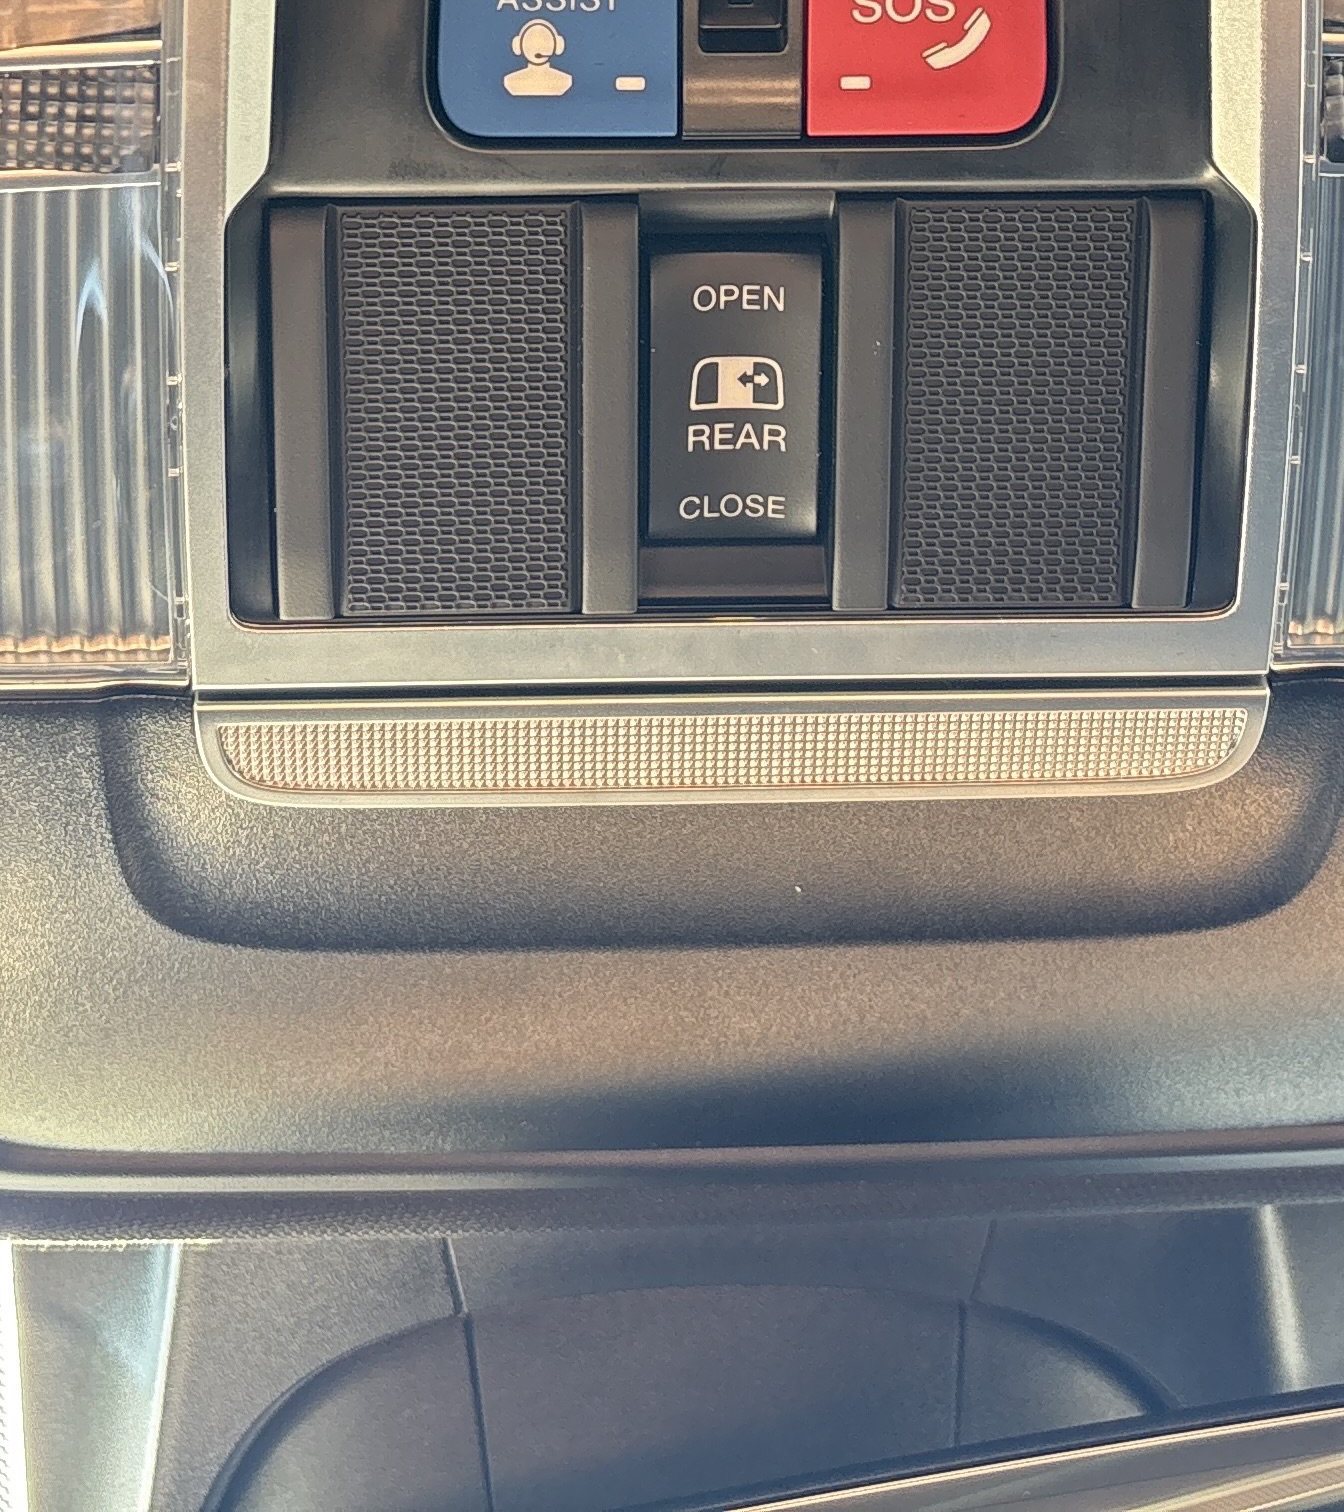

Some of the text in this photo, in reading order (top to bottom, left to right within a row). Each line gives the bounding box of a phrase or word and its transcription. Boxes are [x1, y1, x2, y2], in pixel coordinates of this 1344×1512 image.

[692, 284, 785, 312] OPEN
[687, 423, 787, 453] REAR
[678, 493, 786, 520] CLOSE
